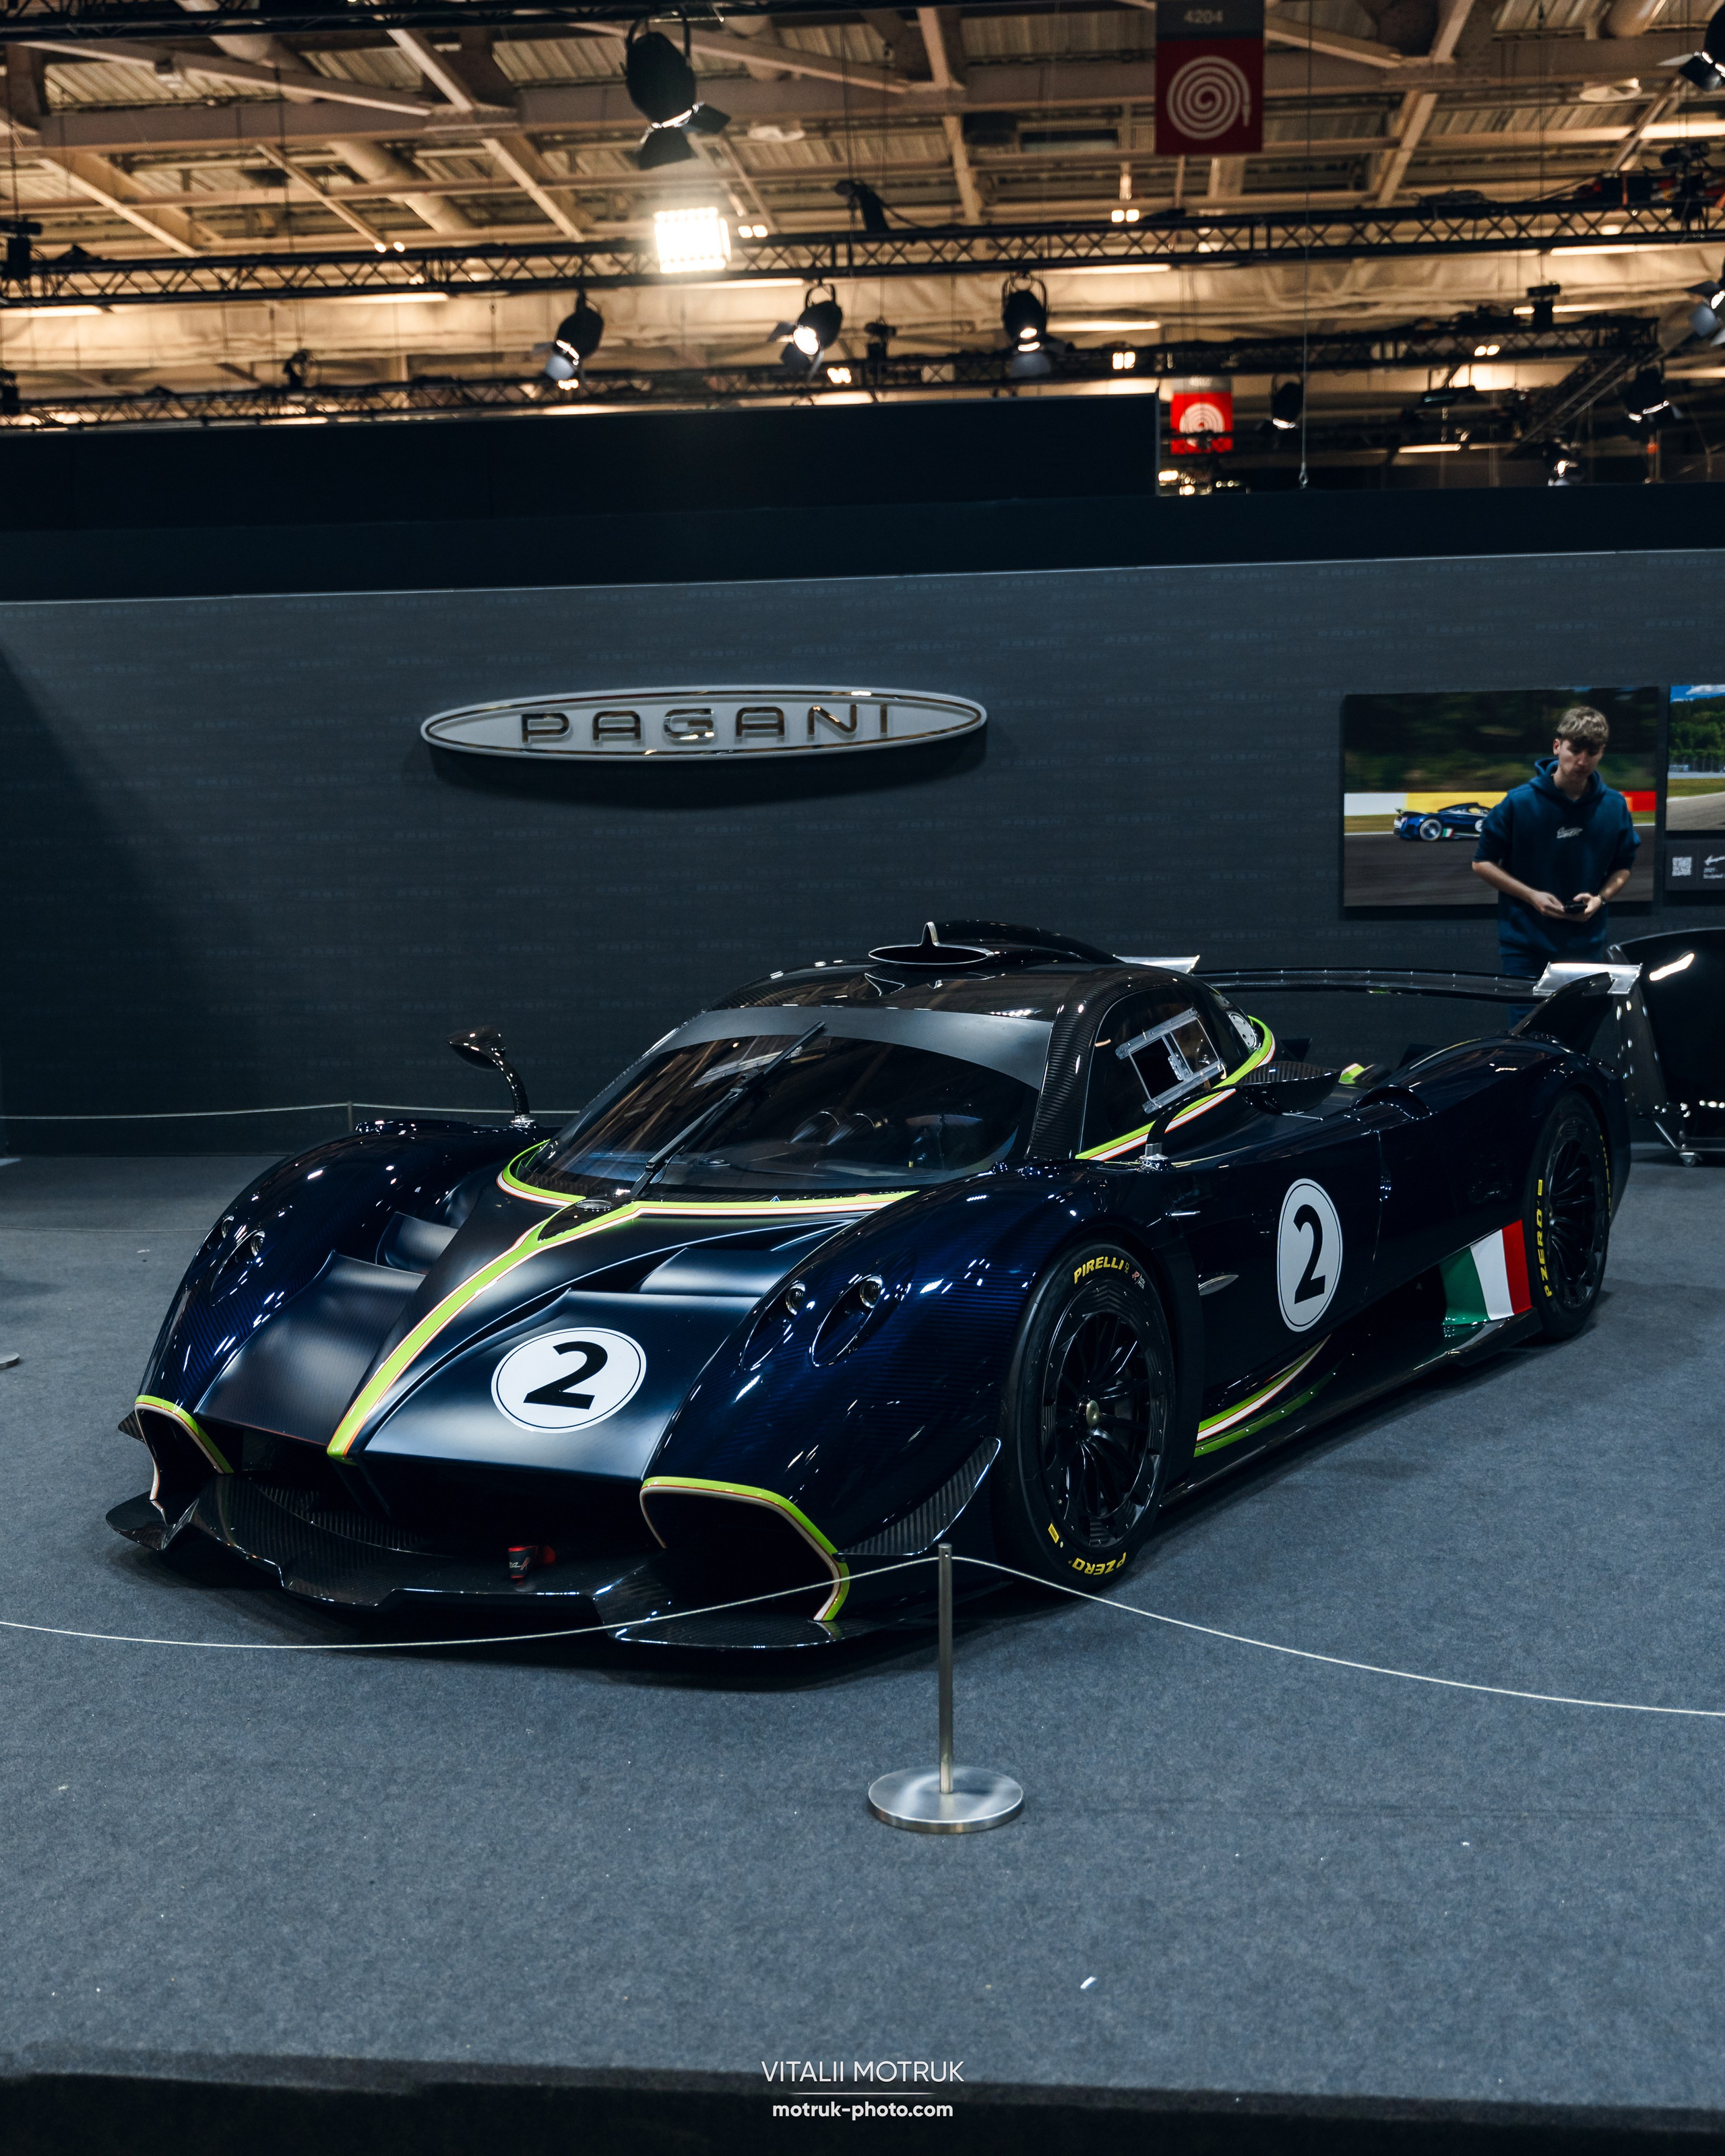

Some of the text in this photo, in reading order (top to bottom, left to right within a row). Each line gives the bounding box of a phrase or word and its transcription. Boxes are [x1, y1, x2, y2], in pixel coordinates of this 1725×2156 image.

[521, 703, 887, 742] PAGANI
[1073, 1257, 1124, 1284] PIRELLI
[1293, 1204, 1325, 1304] 2
[523, 1341, 608, 1410] 2
